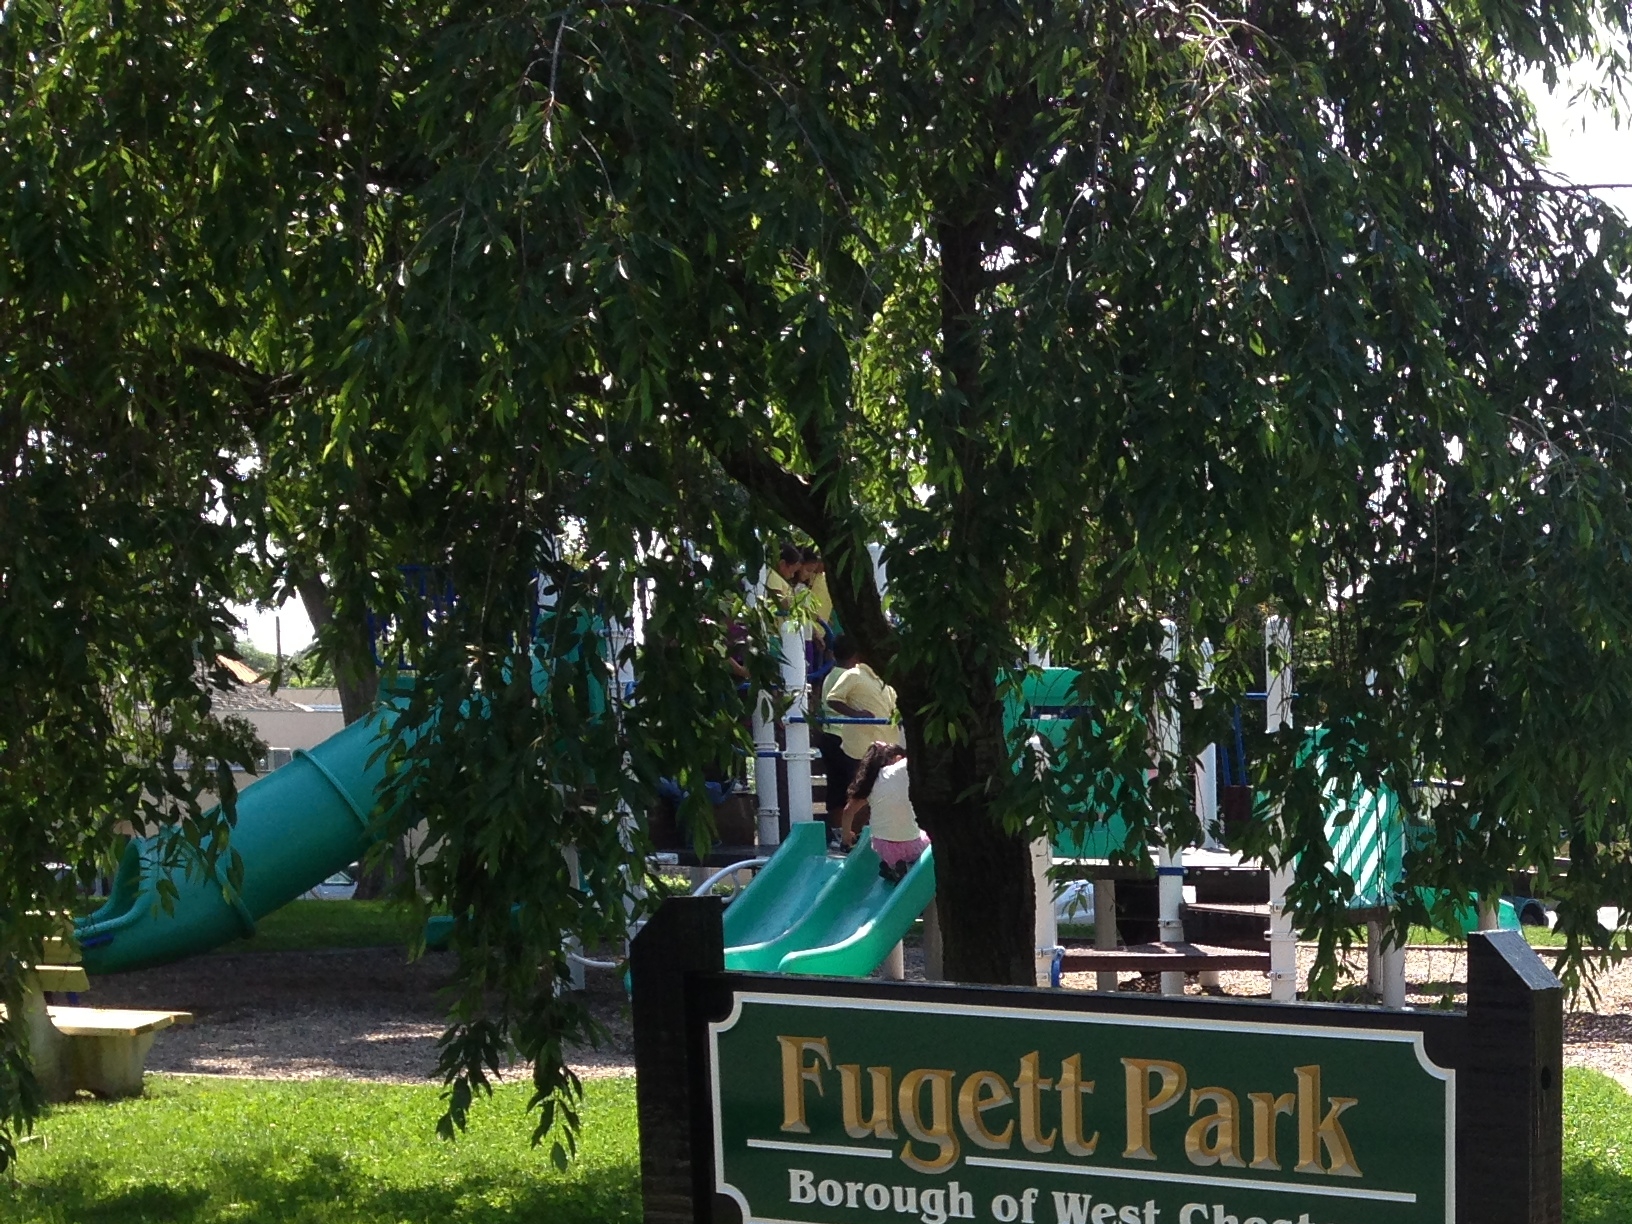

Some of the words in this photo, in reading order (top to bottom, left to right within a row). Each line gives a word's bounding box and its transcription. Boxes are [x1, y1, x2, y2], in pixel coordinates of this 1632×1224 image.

[776, 1035, 1100, 1174] Fugett
[1120, 1056, 1362, 1177] Park
[992, 1188, 1039, 1224] of
